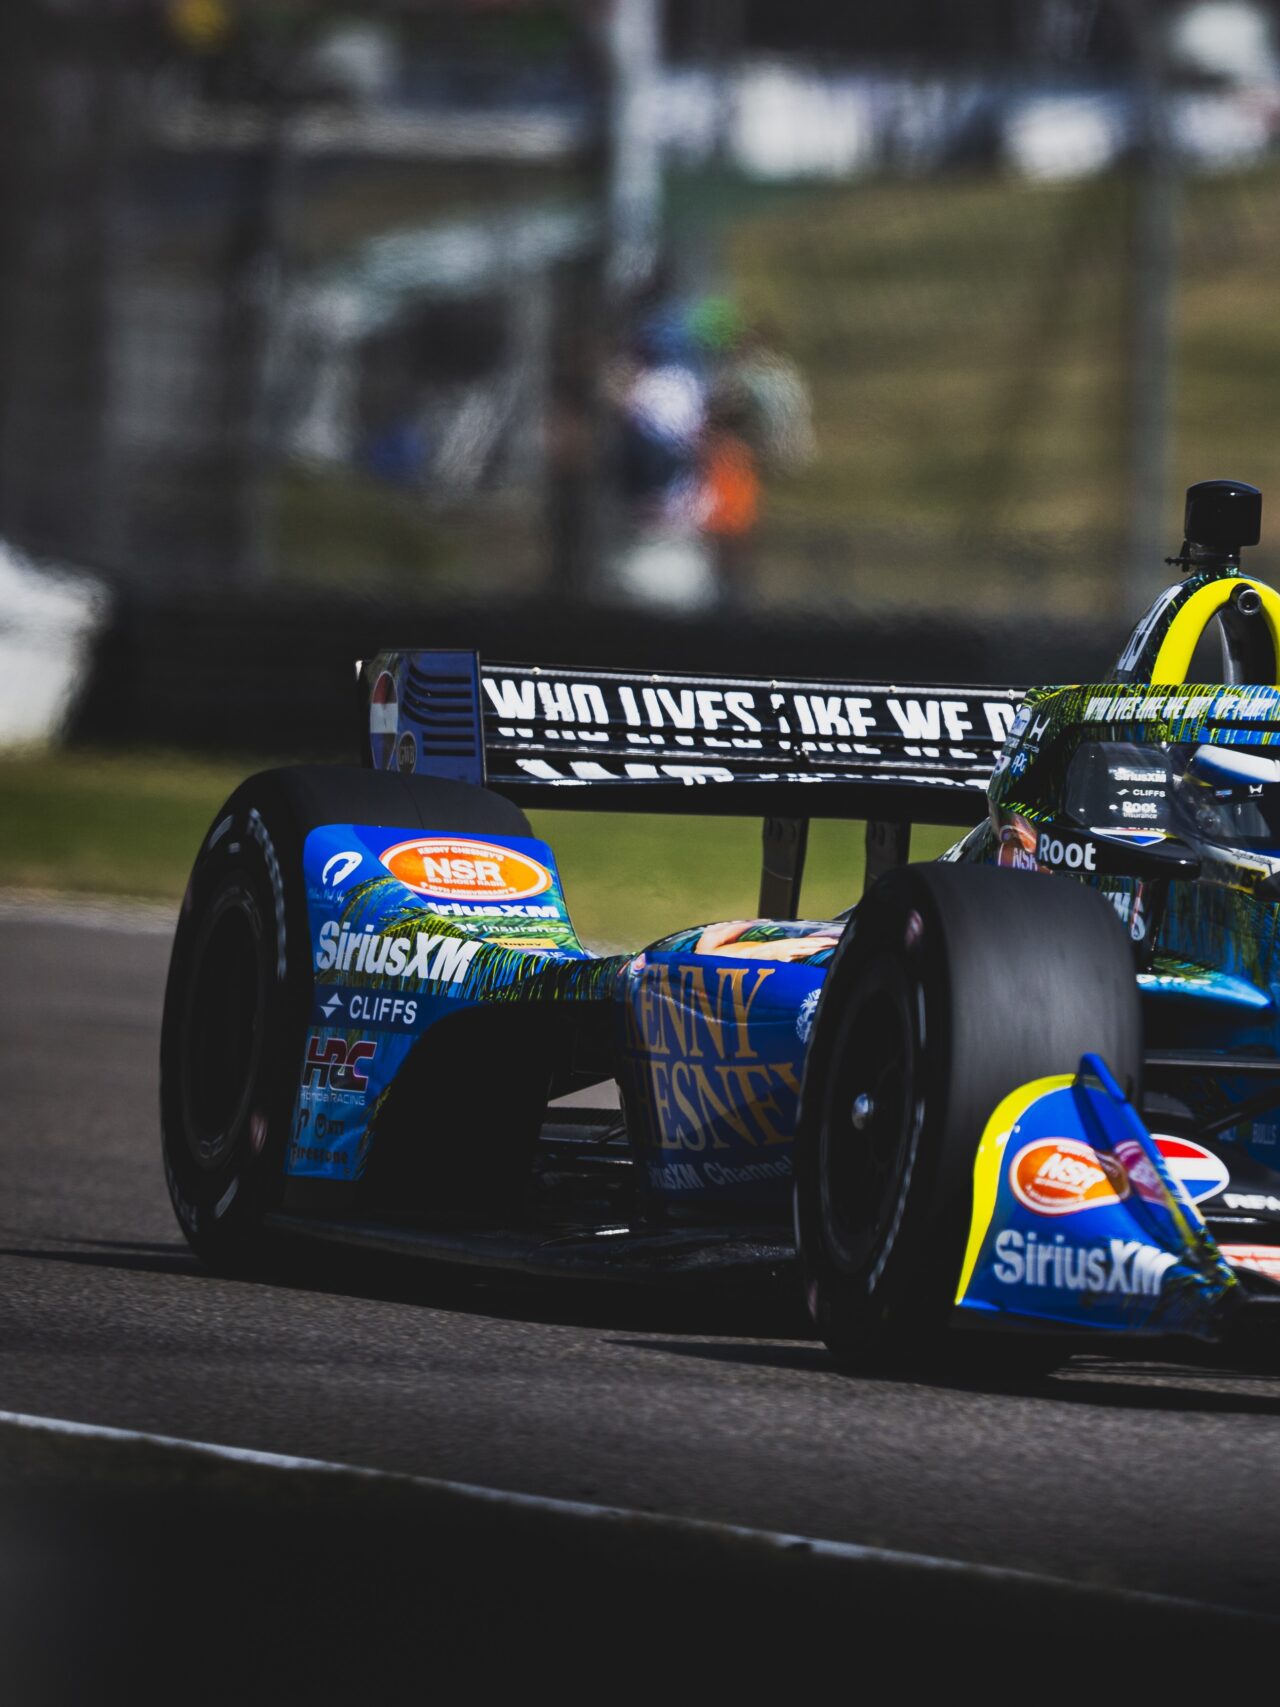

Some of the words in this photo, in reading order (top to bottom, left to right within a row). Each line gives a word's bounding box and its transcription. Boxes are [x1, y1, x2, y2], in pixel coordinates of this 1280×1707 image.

[482, 678, 609, 741] WHO
[618, 686, 763, 748] LIVES
[887, 699, 979, 759] WE
[983, 702, 1024, 759] D
[1132, 788, 1166, 798] CLIFFS
[422, 857, 502, 883] NSR
[1038, 833, 1097, 871] Root
[428, 902, 562, 919] iriusXM
[317, 921, 484, 983] SiriusXM
[349, 994, 418, 1025] CLIFFS
[634, 964, 776, 1058] ENNY
[636, 1060, 802, 1150] ESNE
[1037, 1152, 1107, 1188] NSR
[993, 1229, 1180, 1296] SiriusXM
